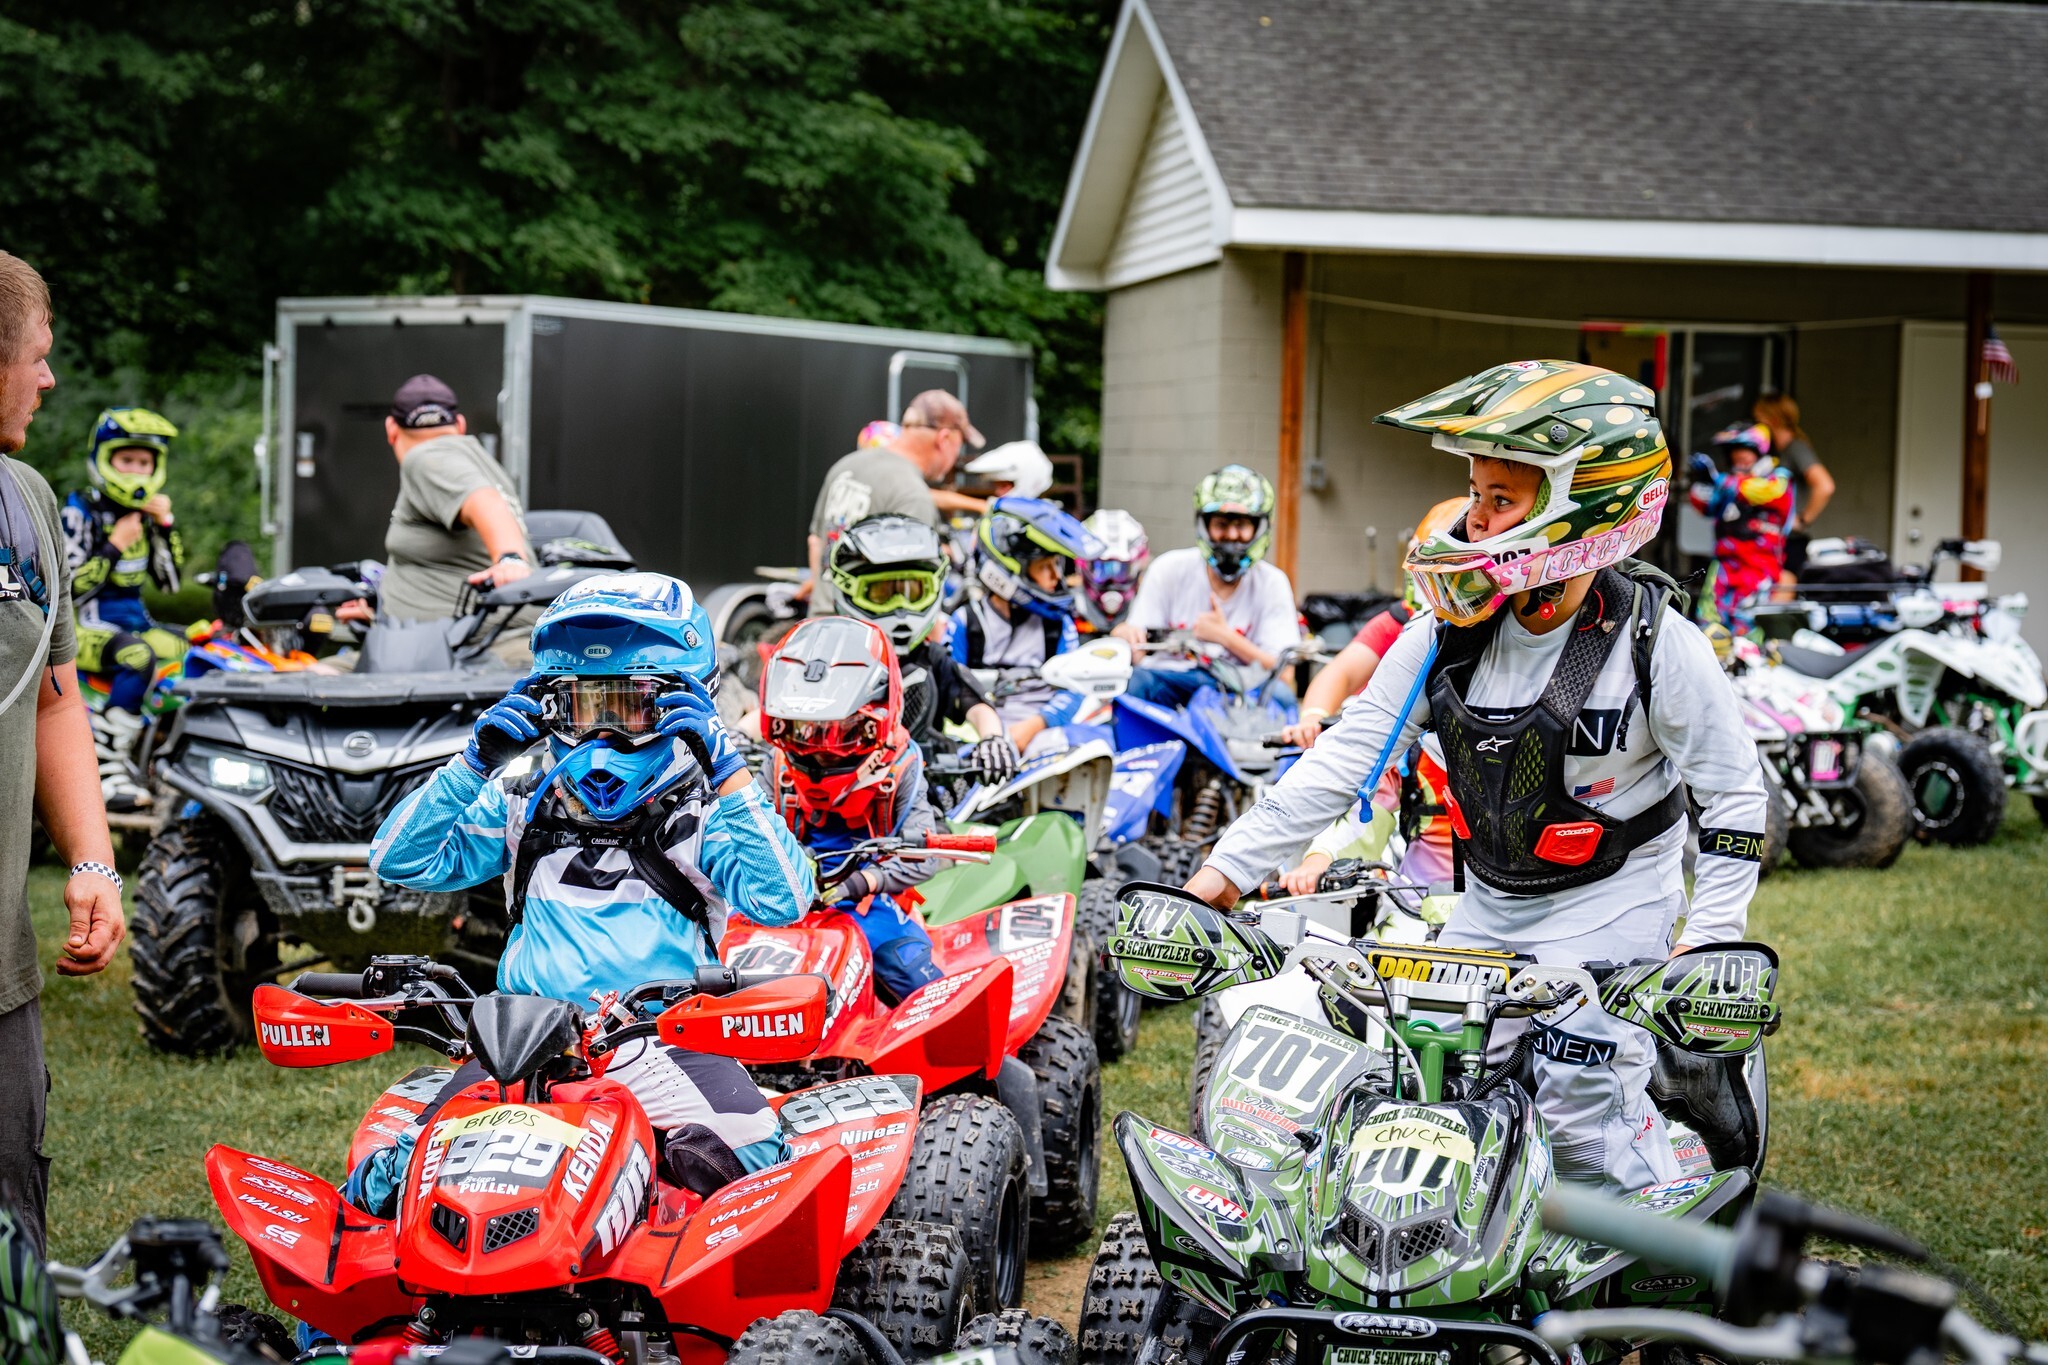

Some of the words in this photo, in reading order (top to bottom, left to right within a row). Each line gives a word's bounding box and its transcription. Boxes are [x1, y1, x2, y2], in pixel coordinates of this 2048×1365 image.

[1643, 486, 1664, 505] BELL
[1521, 512, 1658, 589] 100%
[1126, 895, 1191, 938] 707
[731, 945, 798, 974] 104
[1126, 940, 1191, 962] SCHNITZLER
[1702, 955, 1761, 997] 707
[1693, 1000, 1759, 1019] SCHNITZLER
[261, 1022, 330, 1047] PULLEN
[721, 1012, 804, 1038] PULLEN
[1256, 1012, 1290, 1027] CHUCK
[1293, 1023, 1357, 1052] SCHNITZLER
[1232, 1025, 1348, 1103] 707
[780, 1081, 914, 1134] 929
[1221, 1097, 1254, 1114] AUTO
[1256, 1108, 1301, 1133] REPAIR
[1365, 1108, 1401, 1126] CHUCK
[1402, 1107, 1468, 1136] SCHNITZLER
[840, 1122, 907, 1146] Nine2
[439, 1129, 566, 1177] 929
[562, 1118, 614, 1203] KENDA
[241, 1176, 316, 1204] AXIS
[459, 1180, 520, 1196] PULLEN
[1187, 1186, 1244, 1220] UNI
[238, 1193, 310, 1224] WALSH
[709, 1191, 779, 1227] WALSH
[1504, 1199, 1533, 1267] AXIS
[1638, 1276, 1693, 1289] RATH
[1341, 1314, 1431, 1335] RATH
[1337, 1348, 1372, 1364] CHUCK
[1374, 1350, 1438, 1365] SCHNITZLER
